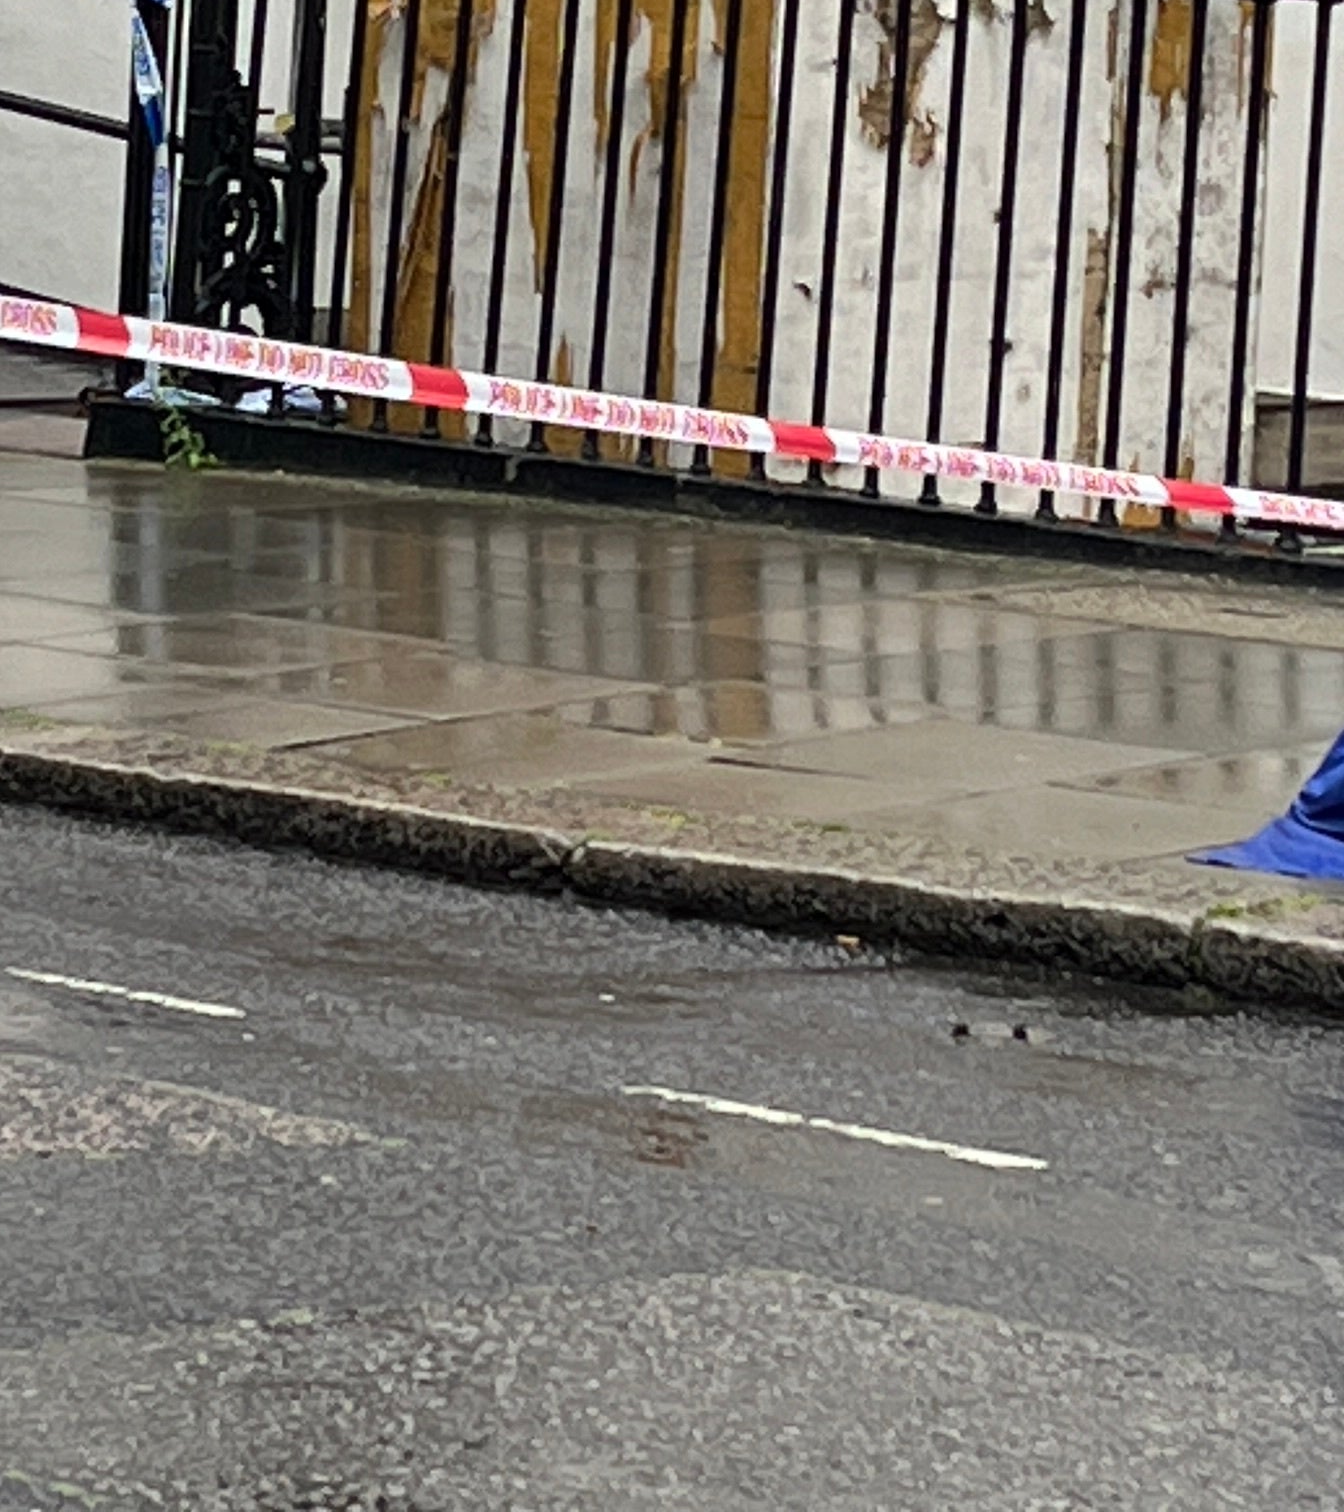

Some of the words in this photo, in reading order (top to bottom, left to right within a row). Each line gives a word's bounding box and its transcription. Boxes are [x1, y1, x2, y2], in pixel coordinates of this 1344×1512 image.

[0, 300, 57, 335] CROSS
[148, 325, 212, 359] POLICE
[214, 336, 255, 368] LINE
[256, 343, 284, 374] DO
[287, 349, 323, 379] NOT
[328, 355, 389, 390] CROSS
